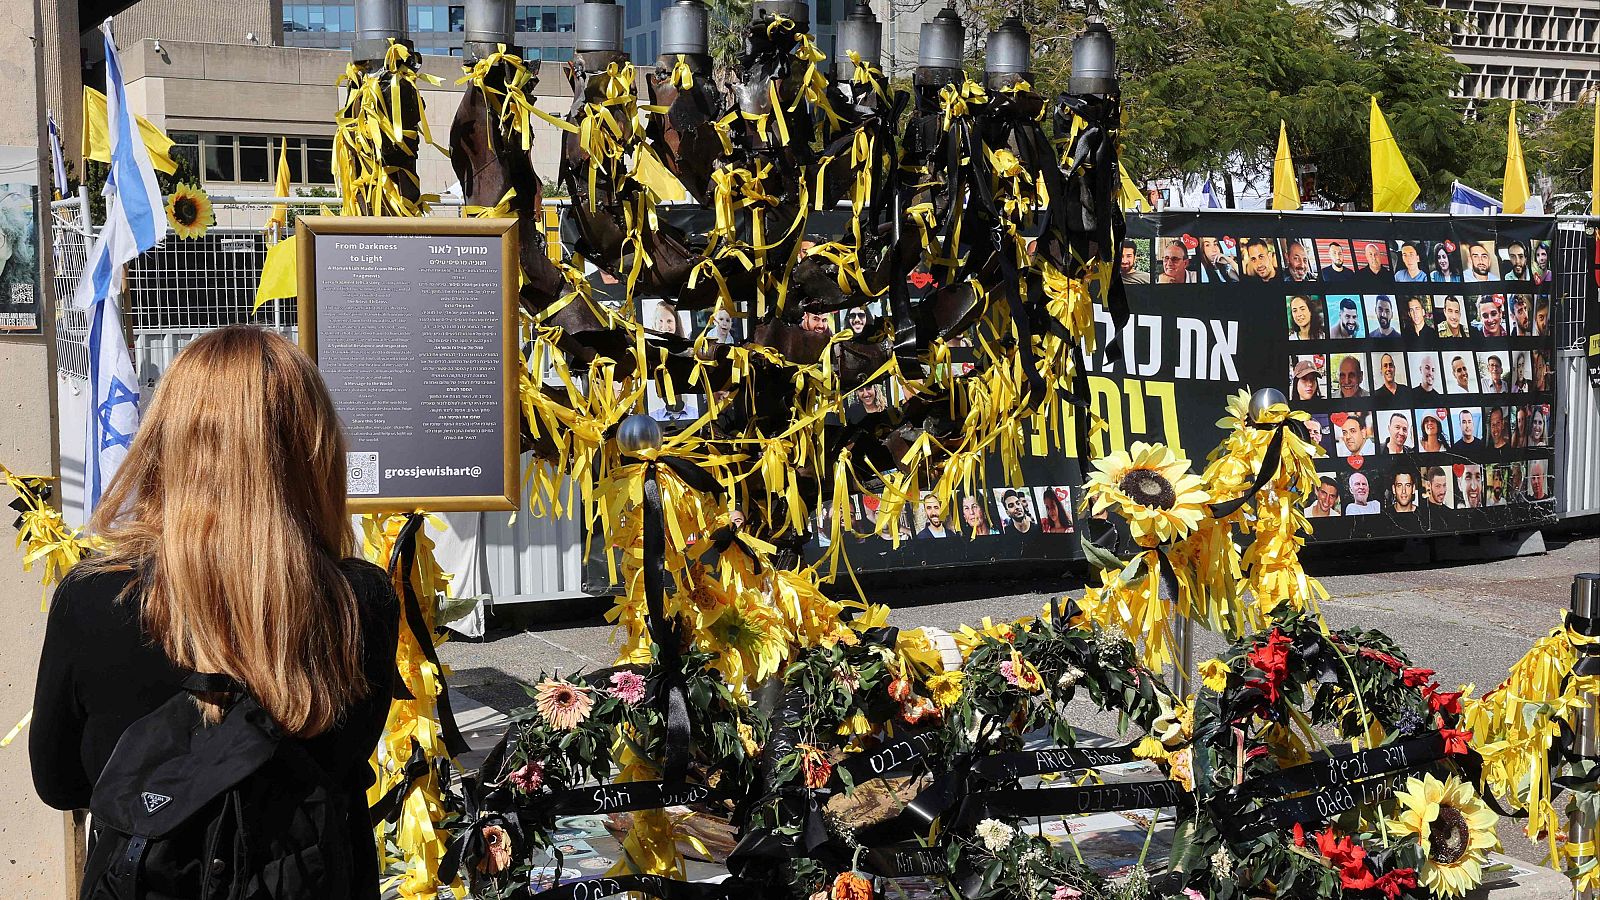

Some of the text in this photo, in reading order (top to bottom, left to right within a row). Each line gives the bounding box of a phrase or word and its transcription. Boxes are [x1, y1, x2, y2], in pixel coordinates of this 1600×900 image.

[335, 241, 398, 250] From Darkness
[361, 254, 383, 264] Light
[428, 244, 488, 257] מחושך לאור
[1175, 316, 1240, 382] את
[869, 741, 921, 774] ביבס
[592, 786, 631, 813] Shiri
[1130, 781, 1181, 808] אריאל
[1316, 786, 1356, 817] Oded
